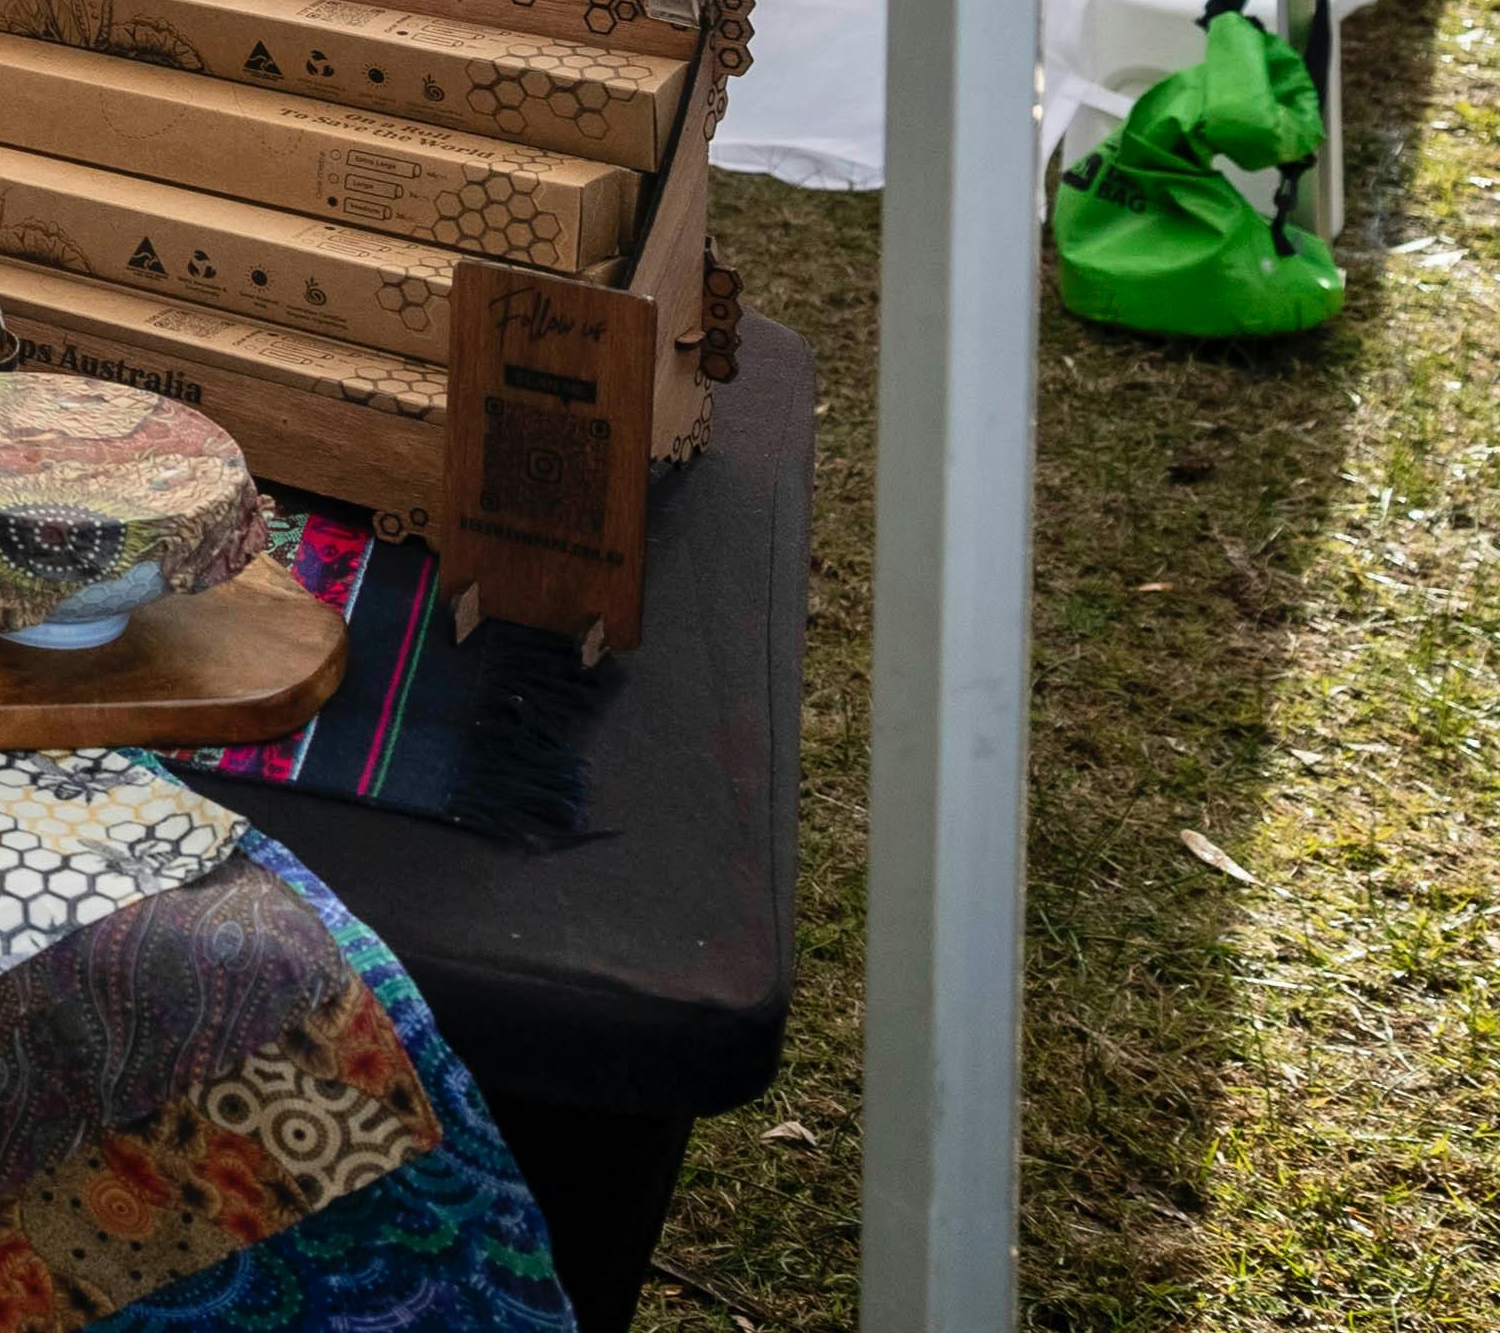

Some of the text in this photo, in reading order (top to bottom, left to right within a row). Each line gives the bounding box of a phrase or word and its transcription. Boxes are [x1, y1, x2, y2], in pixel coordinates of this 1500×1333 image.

[280, 109, 495, 159] To Save the World
[59, 344, 203, 403] Australia
